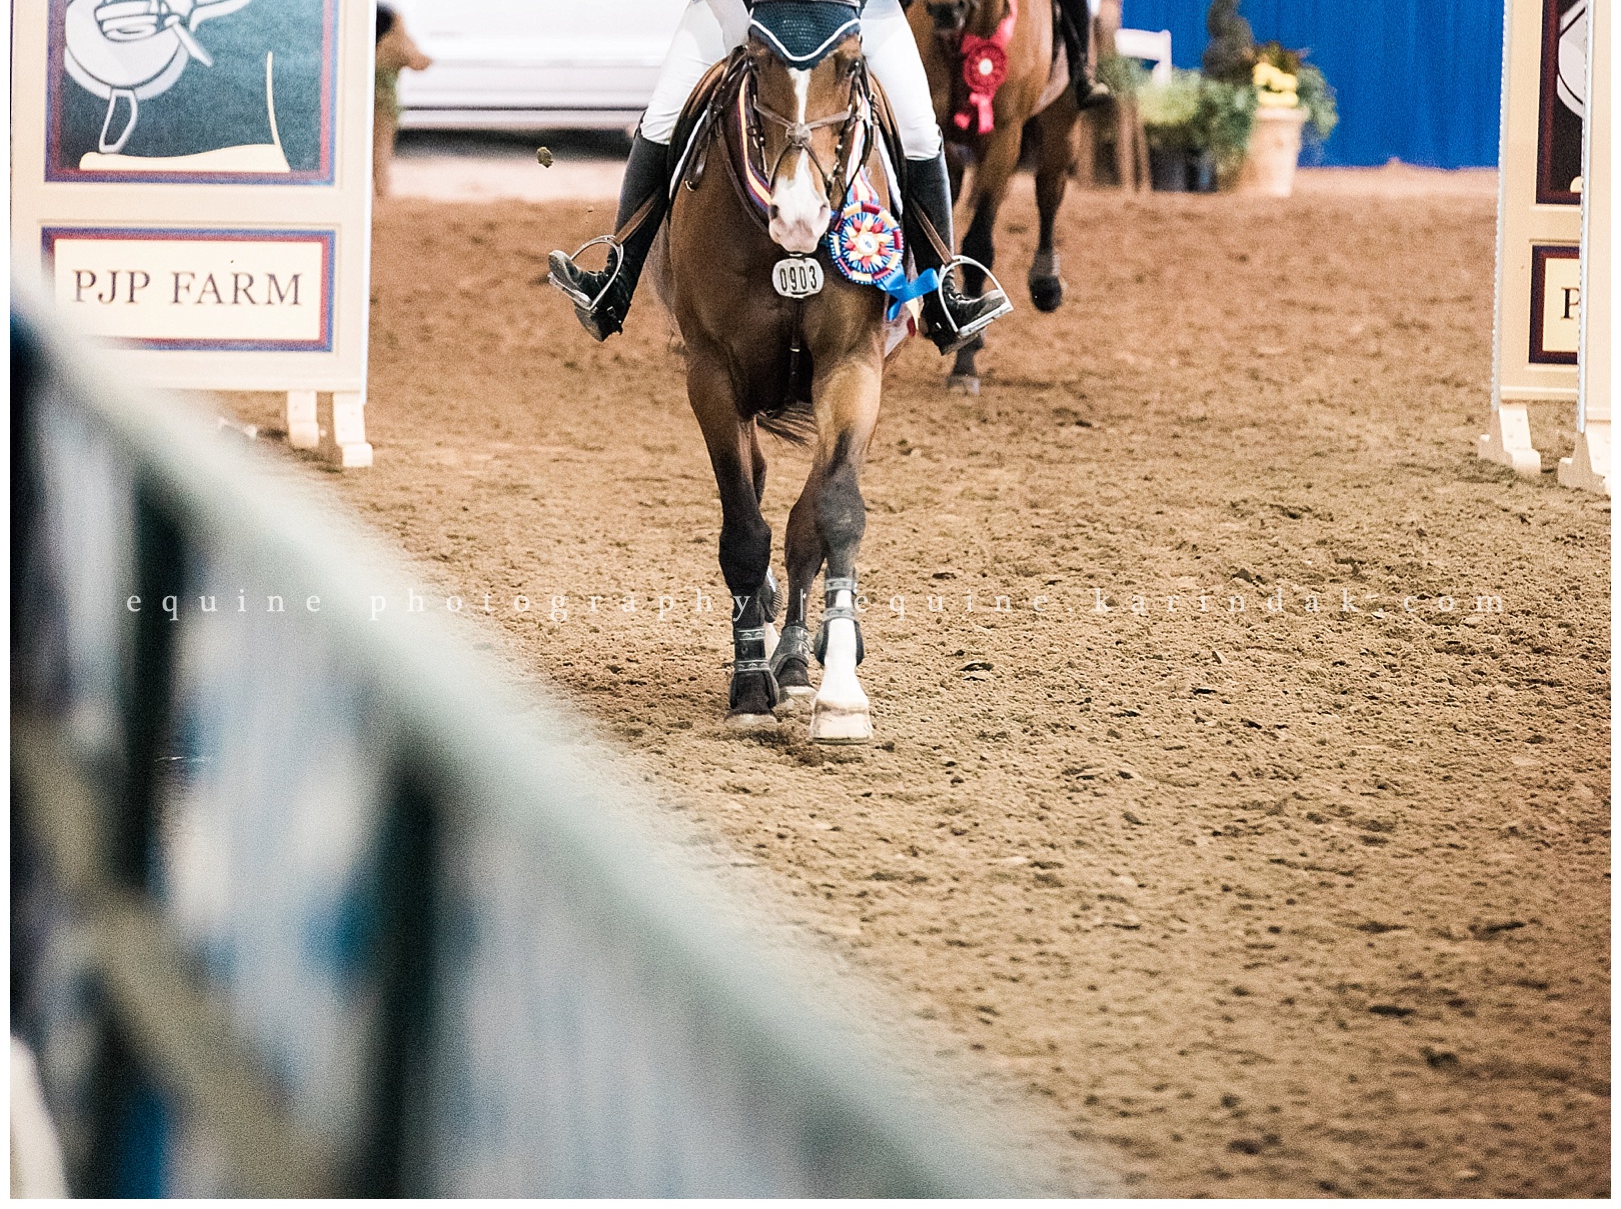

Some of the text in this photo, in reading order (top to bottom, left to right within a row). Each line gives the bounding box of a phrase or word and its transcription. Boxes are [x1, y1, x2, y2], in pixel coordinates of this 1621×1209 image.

[71, 269, 304, 306] PJP FARM
[779, 265, 818, 292] 0903
